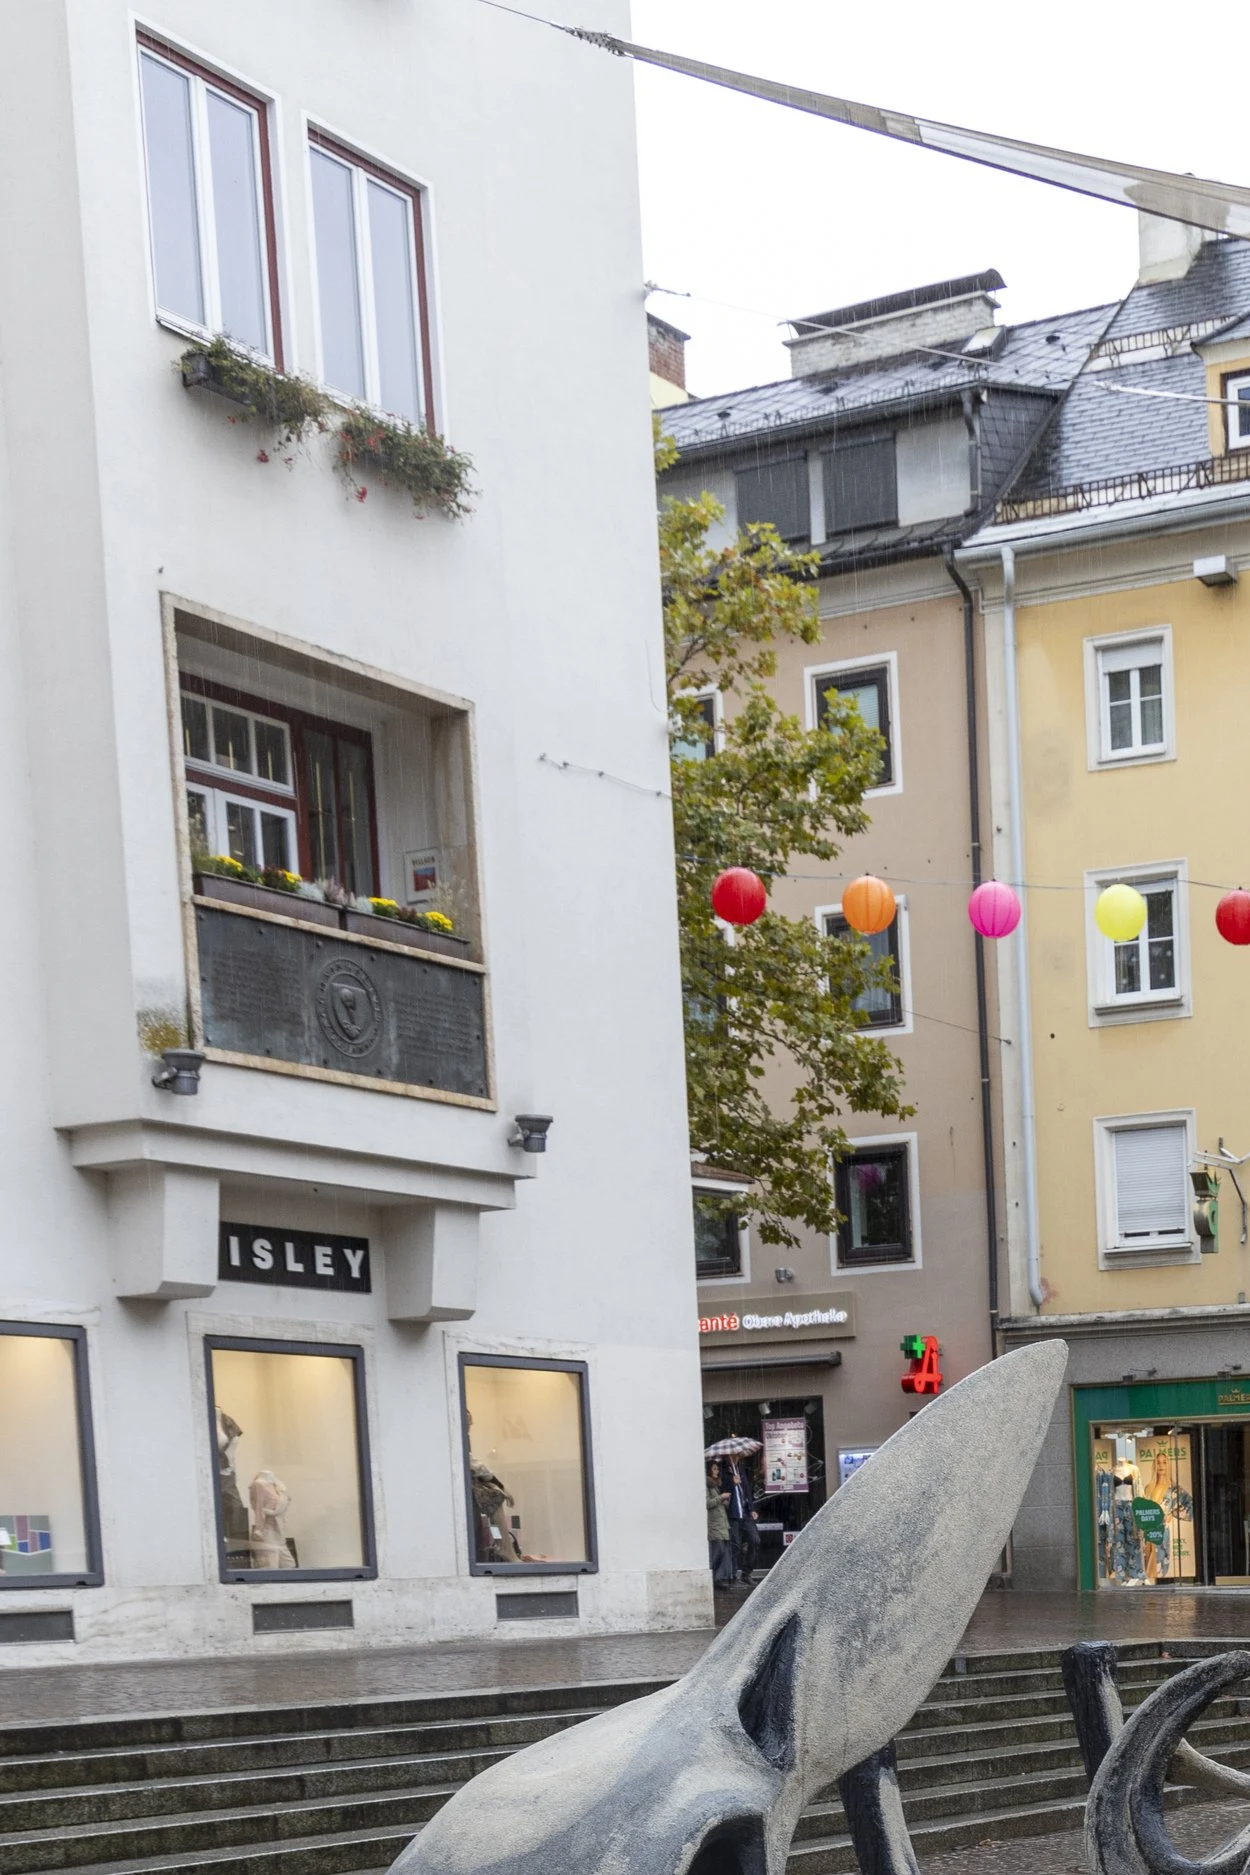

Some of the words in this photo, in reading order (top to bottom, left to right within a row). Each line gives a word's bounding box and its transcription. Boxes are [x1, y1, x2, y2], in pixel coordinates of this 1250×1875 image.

[229, 1235, 364, 1278] ISLEY
[698, 1312, 740, 1332] anté
[742, 1312, 783, 1330] Obere
[784, 1308, 848, 1329] Apotheke
